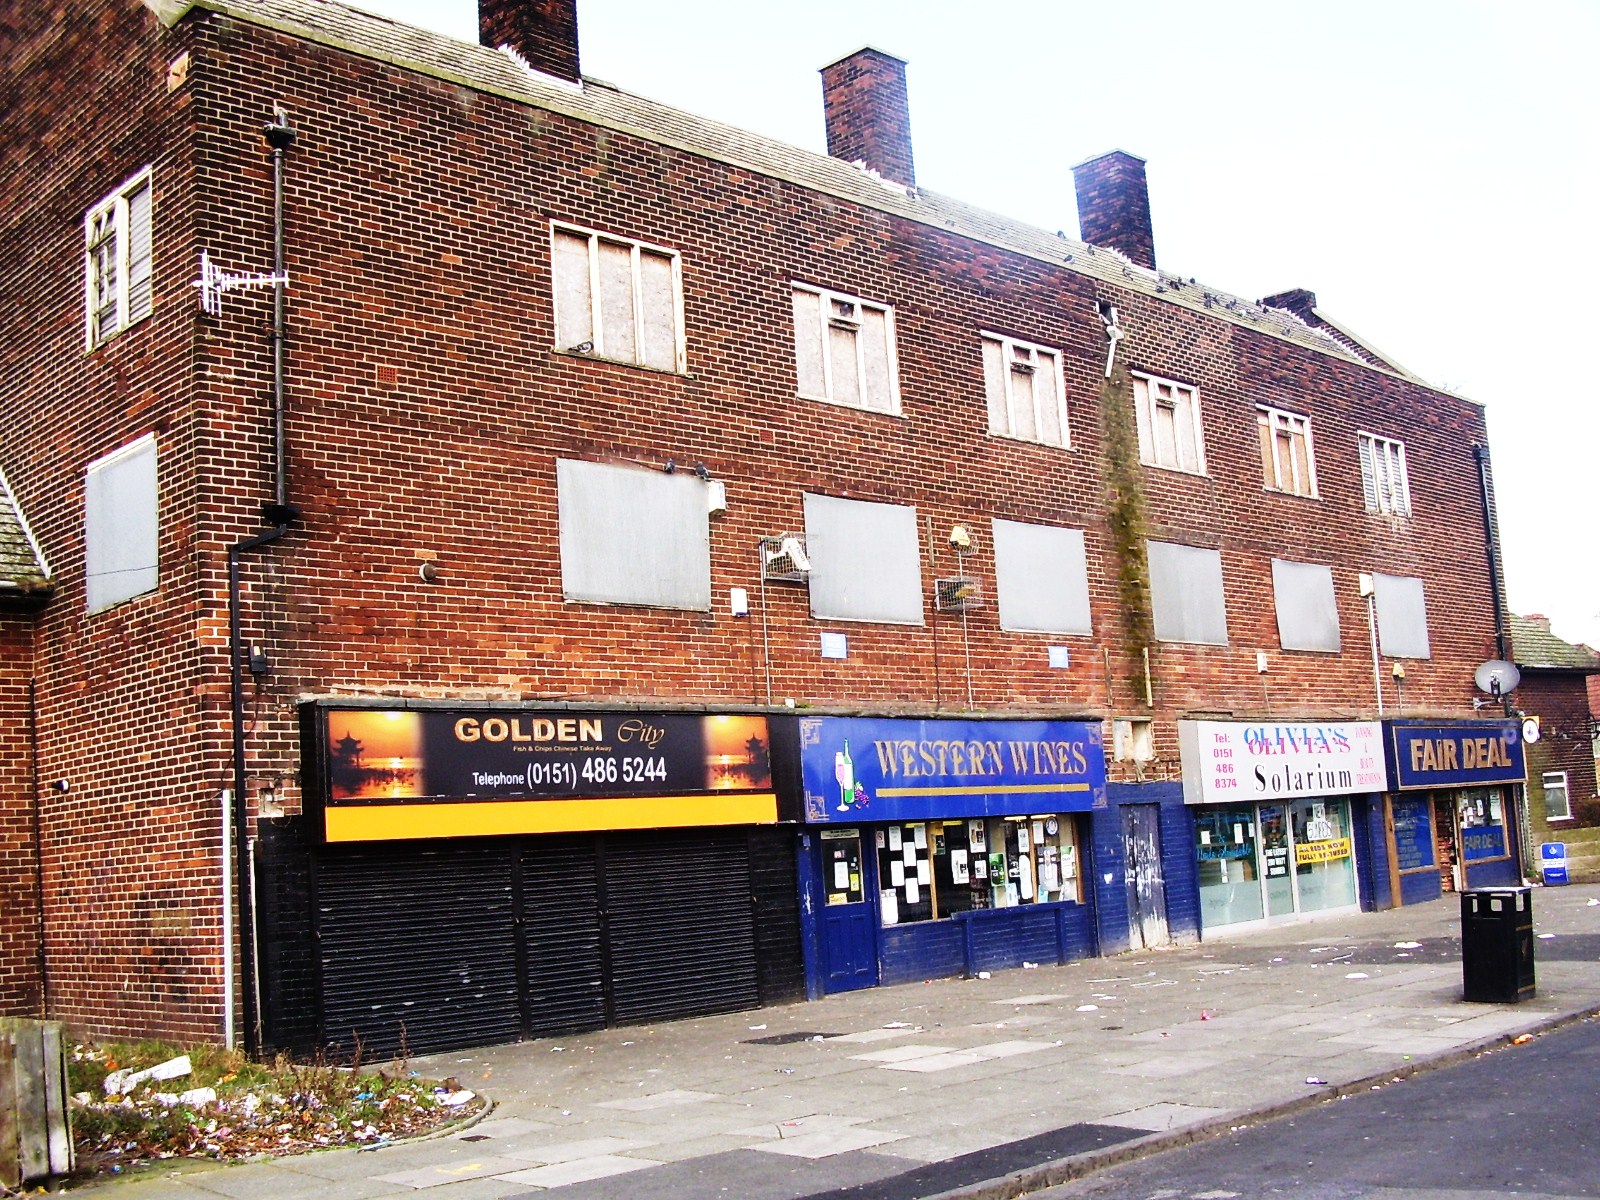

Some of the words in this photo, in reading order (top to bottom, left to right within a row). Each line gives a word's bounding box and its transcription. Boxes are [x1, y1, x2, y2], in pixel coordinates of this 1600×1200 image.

[454, 717, 603, 743] GOLDEN
[617, 719, 665, 749] City
[1214, 733, 1230, 743] Tel:
[1243, 727, 1347, 746] OLIVIA'S
[874, 739, 1004, 778] WESTERN
[1008, 741, 1087, 775] WINES
[1213, 749, 1233, 758] 0151
[1410, 739, 1458, 771] FAIR
[1462, 737, 1512, 769] DEAL
[473, 772, 524, 787] Telephone
[527, 763, 577, 789] (0151)
[581, 757, 618, 784] 486
[622, 756, 667, 783] 5244
[1216, 764, 1234, 773] 486
[1254, 763, 1353, 792] Solarium
[1215, 779, 1237, 789] 8374
